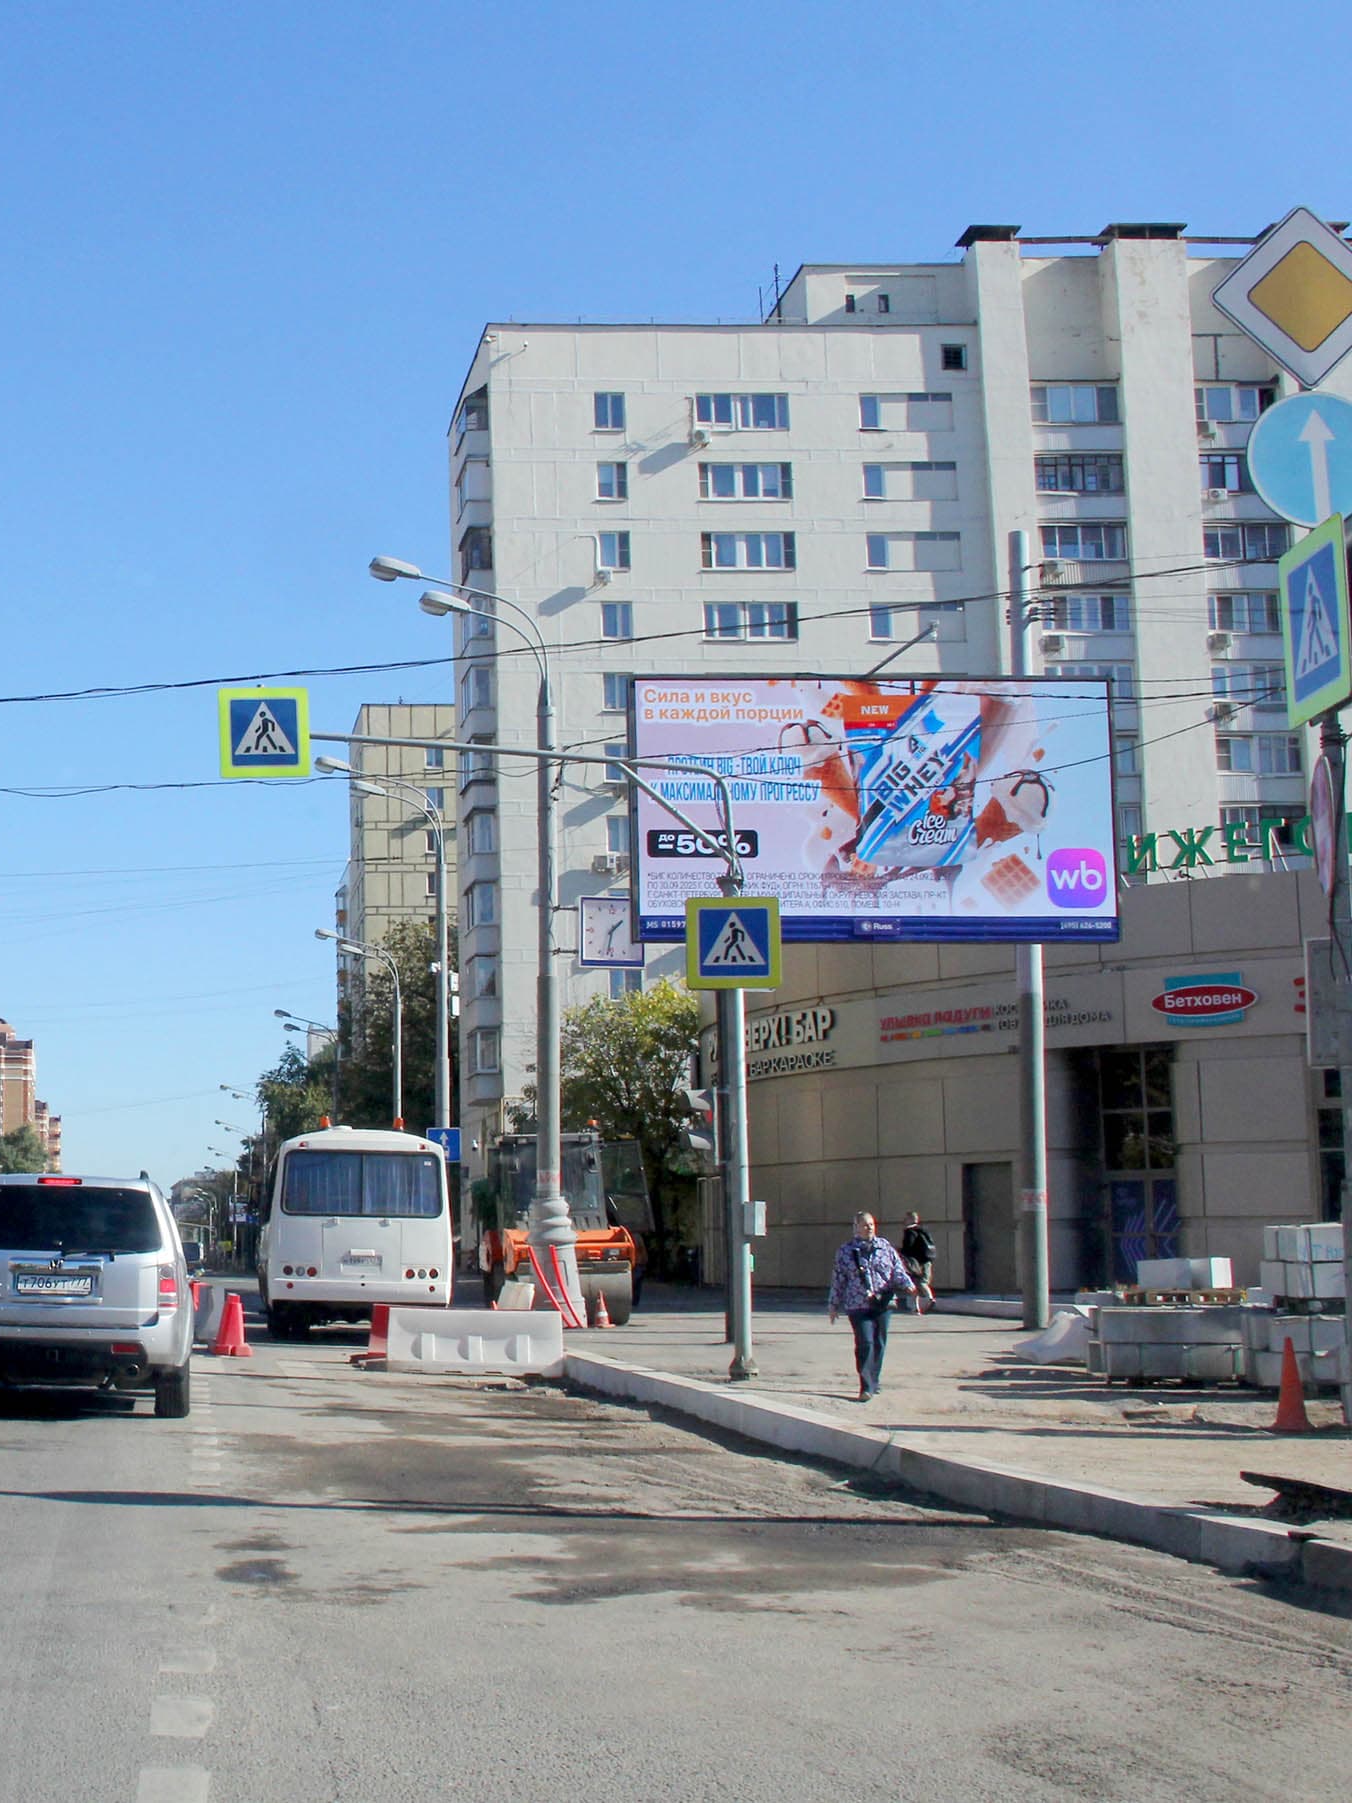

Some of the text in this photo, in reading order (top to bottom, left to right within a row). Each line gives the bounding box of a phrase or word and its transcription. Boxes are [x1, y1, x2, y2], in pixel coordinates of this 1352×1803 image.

[644, 689, 752, 706] Сила и вкус
[644, 706, 804, 722] в каждой порции
[860, 705, 889, 715] NEW
[667, 755, 714, 776] ПРОТЕИН
[718, 757, 734, 775] BIG
[769, 757, 802, 775] КЛЮЧ
[874, 759, 912, 801] BIG
[887, 749, 946, 813] WHEY
[660, 782, 758, 801] МАКСИМАЛНОМУ
[759, 782, 821, 801] ПРОГРЕССУ
[908, 819, 958, 845] Cream
[1049, 860, 1103, 890] wb
[872, 922, 894, 930] Russ
[1164, 991, 1243, 1009] Бетховен
[791, 1006, 834, 1046] БАР
